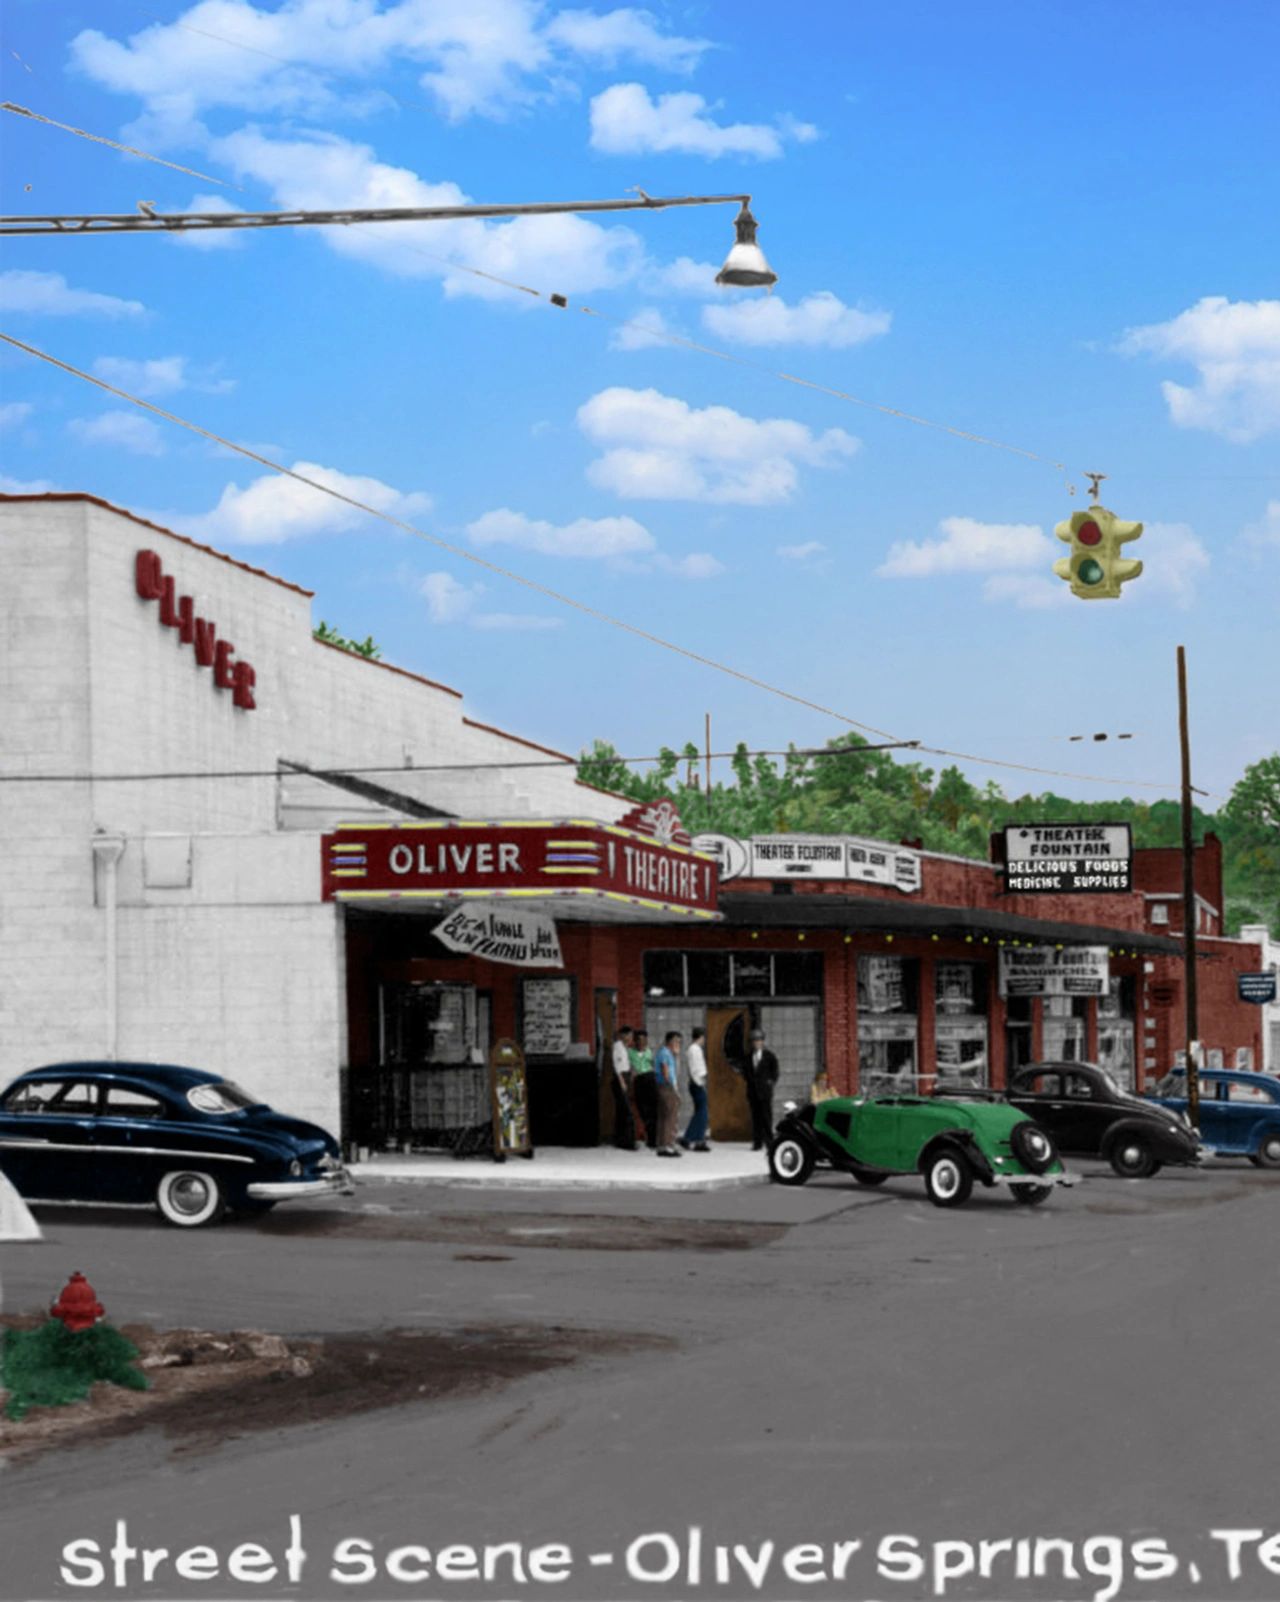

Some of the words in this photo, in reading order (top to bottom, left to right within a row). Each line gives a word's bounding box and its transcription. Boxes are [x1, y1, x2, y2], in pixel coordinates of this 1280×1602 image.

[134, 549, 257, 710] OLIVER
[388, 843, 523, 874] OLIVER
[1030, 842, 1111, 857] FOUNTAIN
[622, 845, 700, 901] THEATRE
[1008, 861, 1078, 879] DELICIOUS
[1084, 860, 1129, 878] FOODS
[1008, 876, 1062, 890] MEDICINE
[1073, 874, 1128, 889] SUPPLIES
